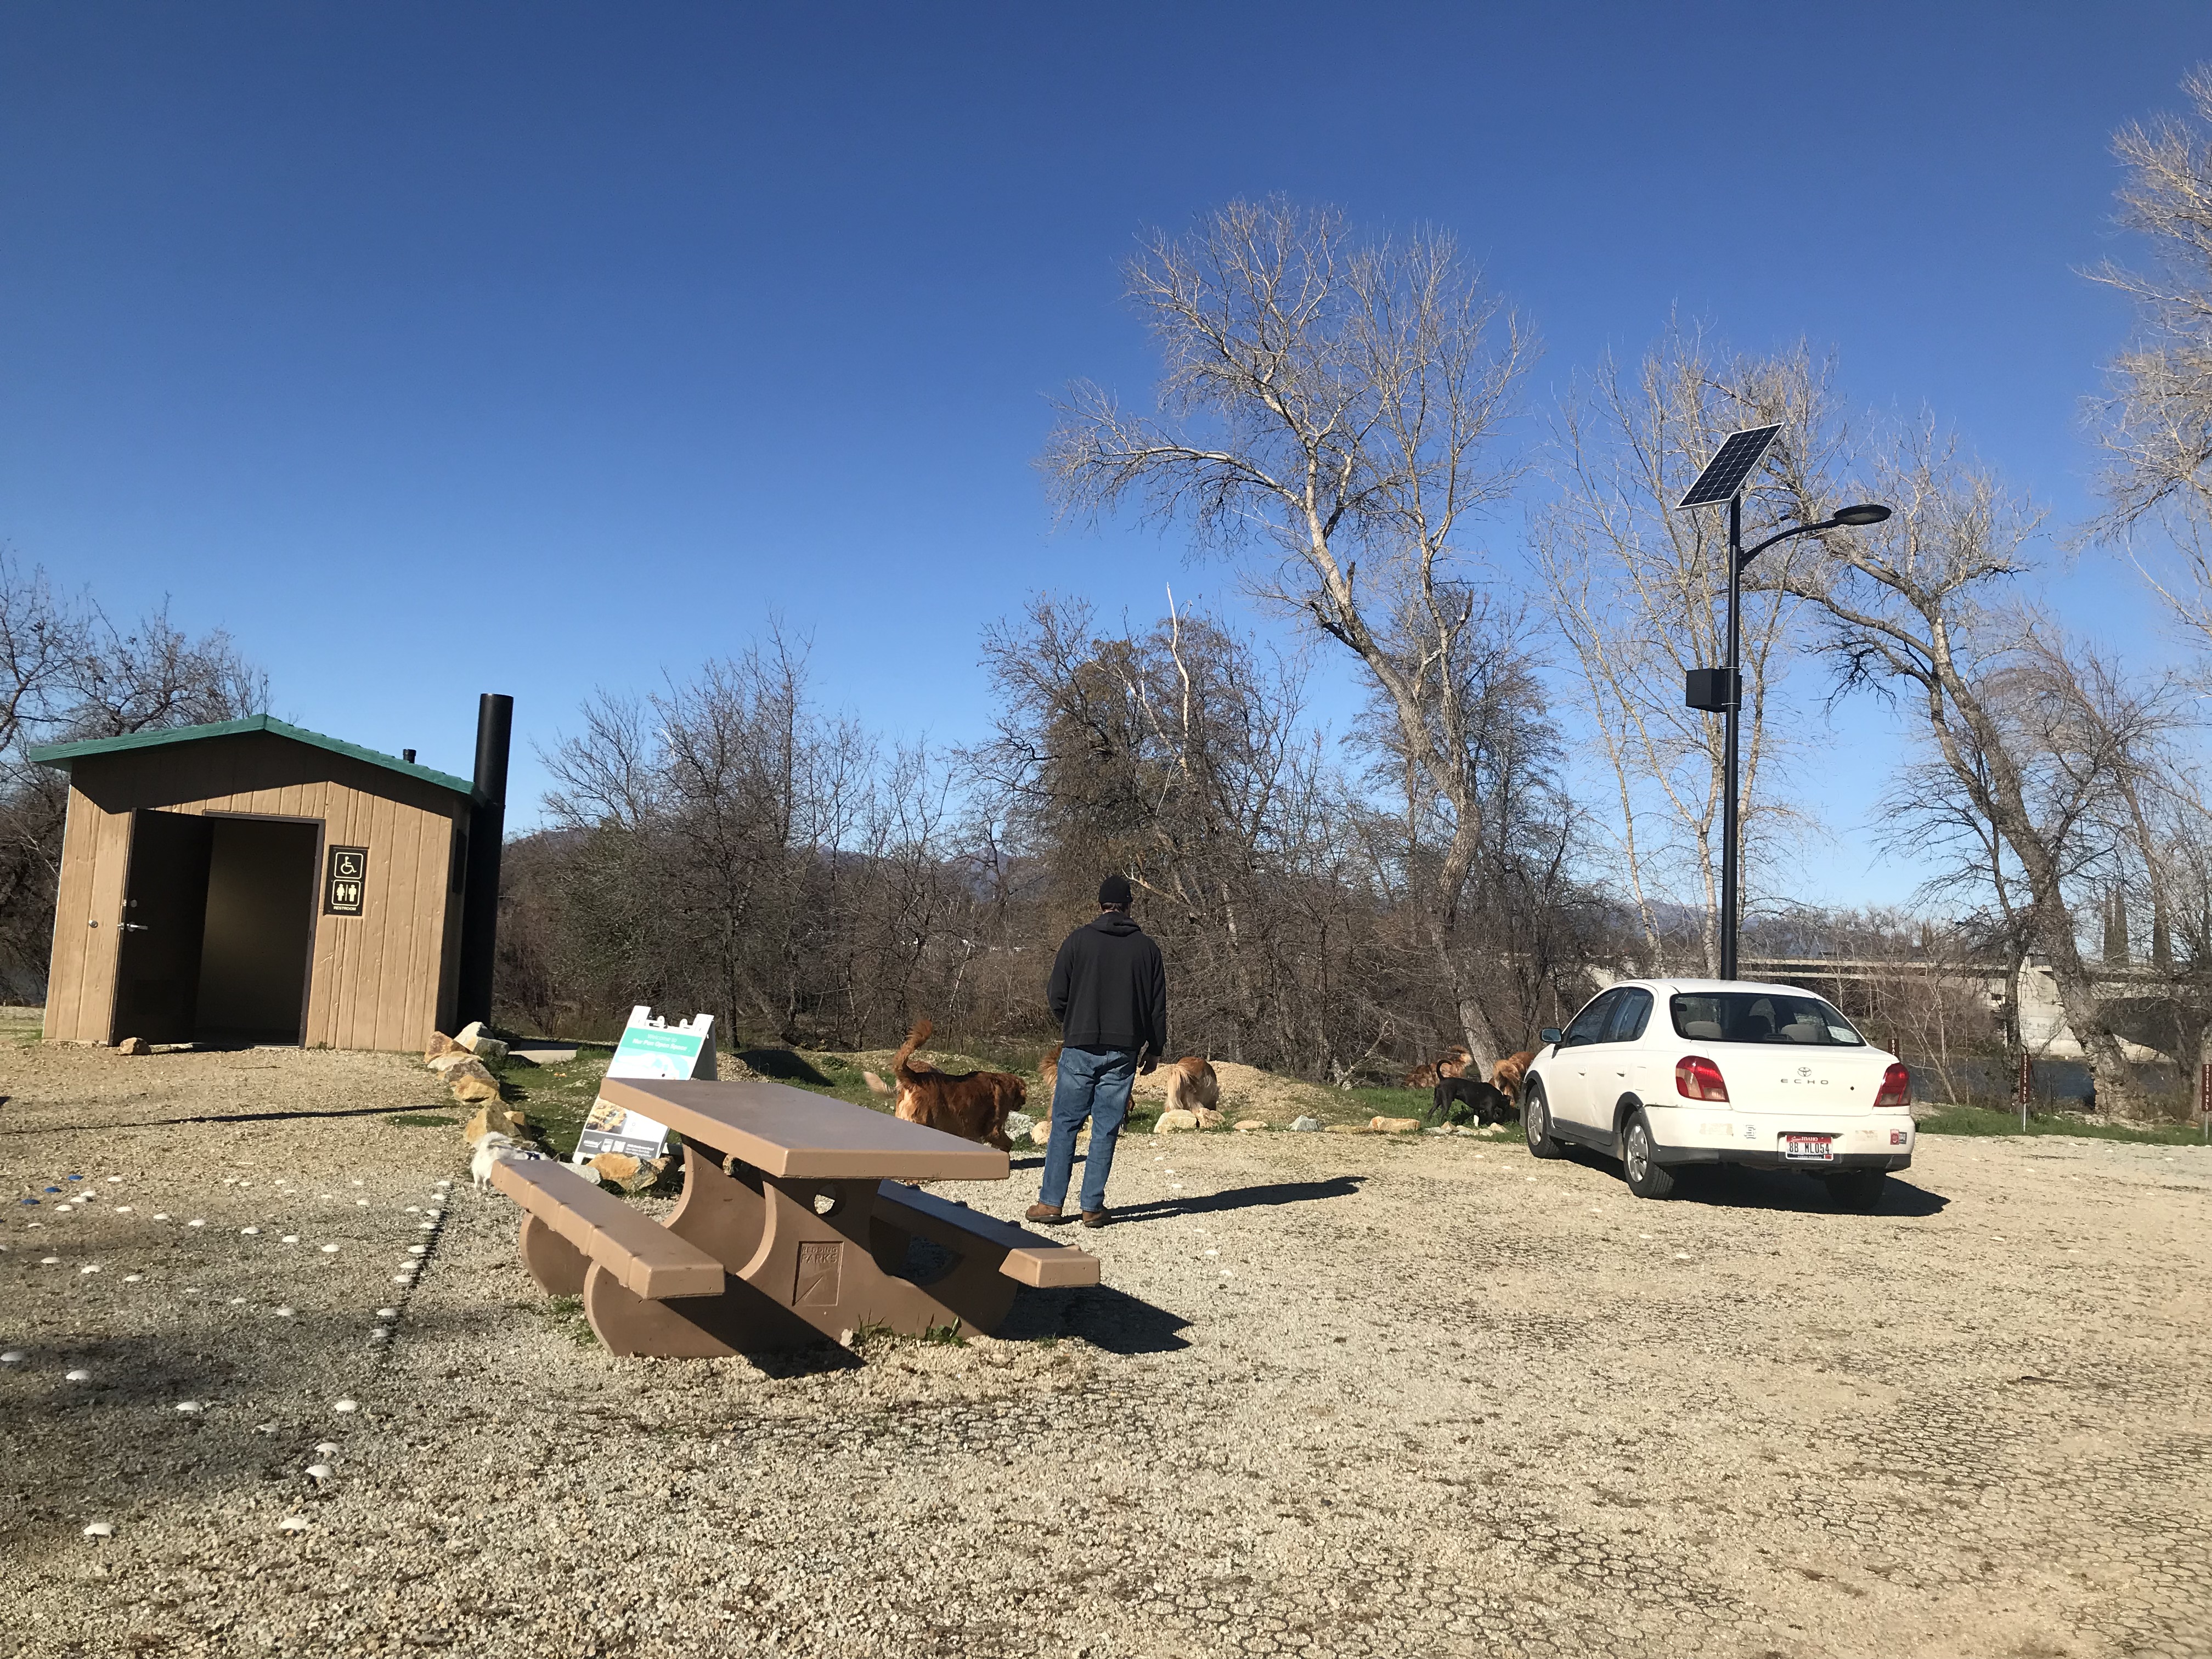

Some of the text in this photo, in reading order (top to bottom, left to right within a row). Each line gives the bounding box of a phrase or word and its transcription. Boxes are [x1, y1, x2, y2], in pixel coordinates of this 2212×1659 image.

[647, 1034, 671, 1042] Welcome
[669, 1043, 688, 1051] Space
[1789, 1142, 1799, 1153] 8B
[801, 1254, 837, 1263] PARKS
